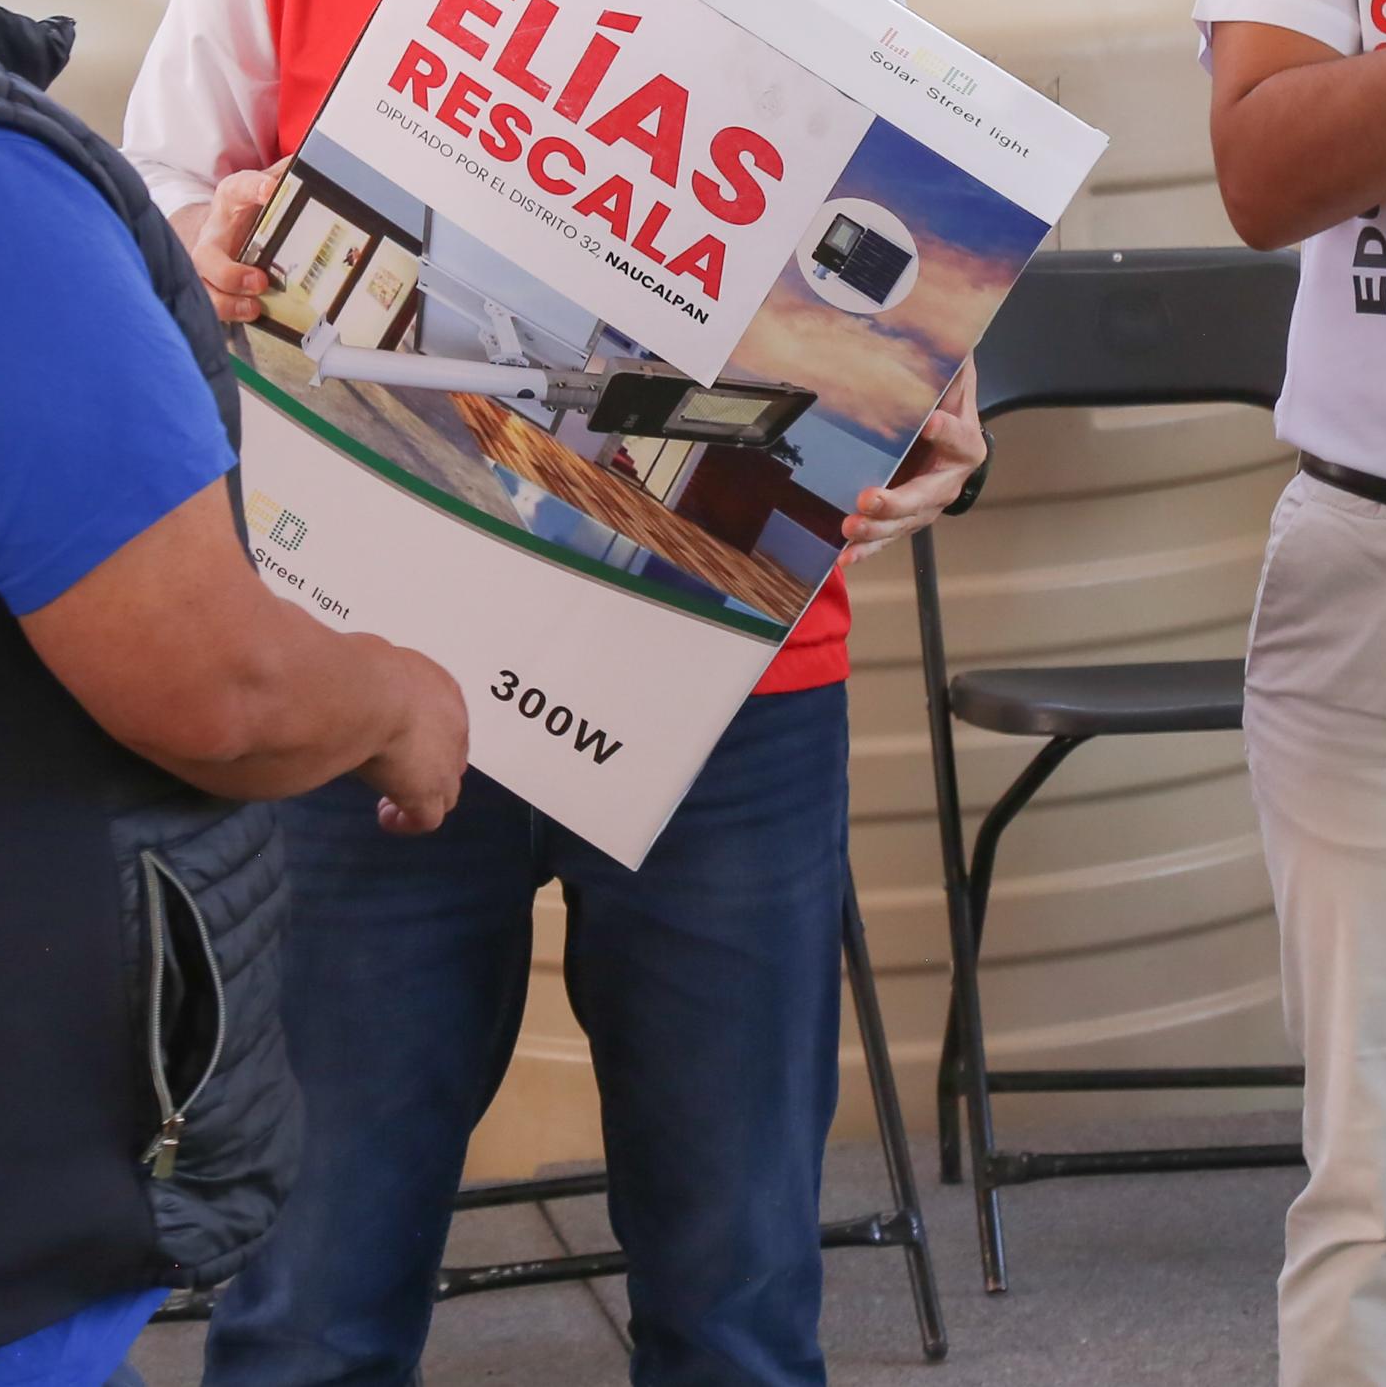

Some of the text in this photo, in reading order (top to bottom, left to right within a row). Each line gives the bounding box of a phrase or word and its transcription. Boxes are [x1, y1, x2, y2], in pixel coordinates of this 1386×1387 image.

[869, 50, 1030, 158] Solar Street light
[376, 99, 453, 159] DIPUTADO
[455, 152, 490, 184] POR
[490, 176, 506, 196] EL
[509, 188, 579, 242] DISTRITO
[604, 251, 710, 326] NAUCALPAN
[387, 39, 727, 302] RESCALA
[244, 489, 308, 551] ED
[253, 548, 350, 620] Street light
[490, 669, 624, 766] 300W
